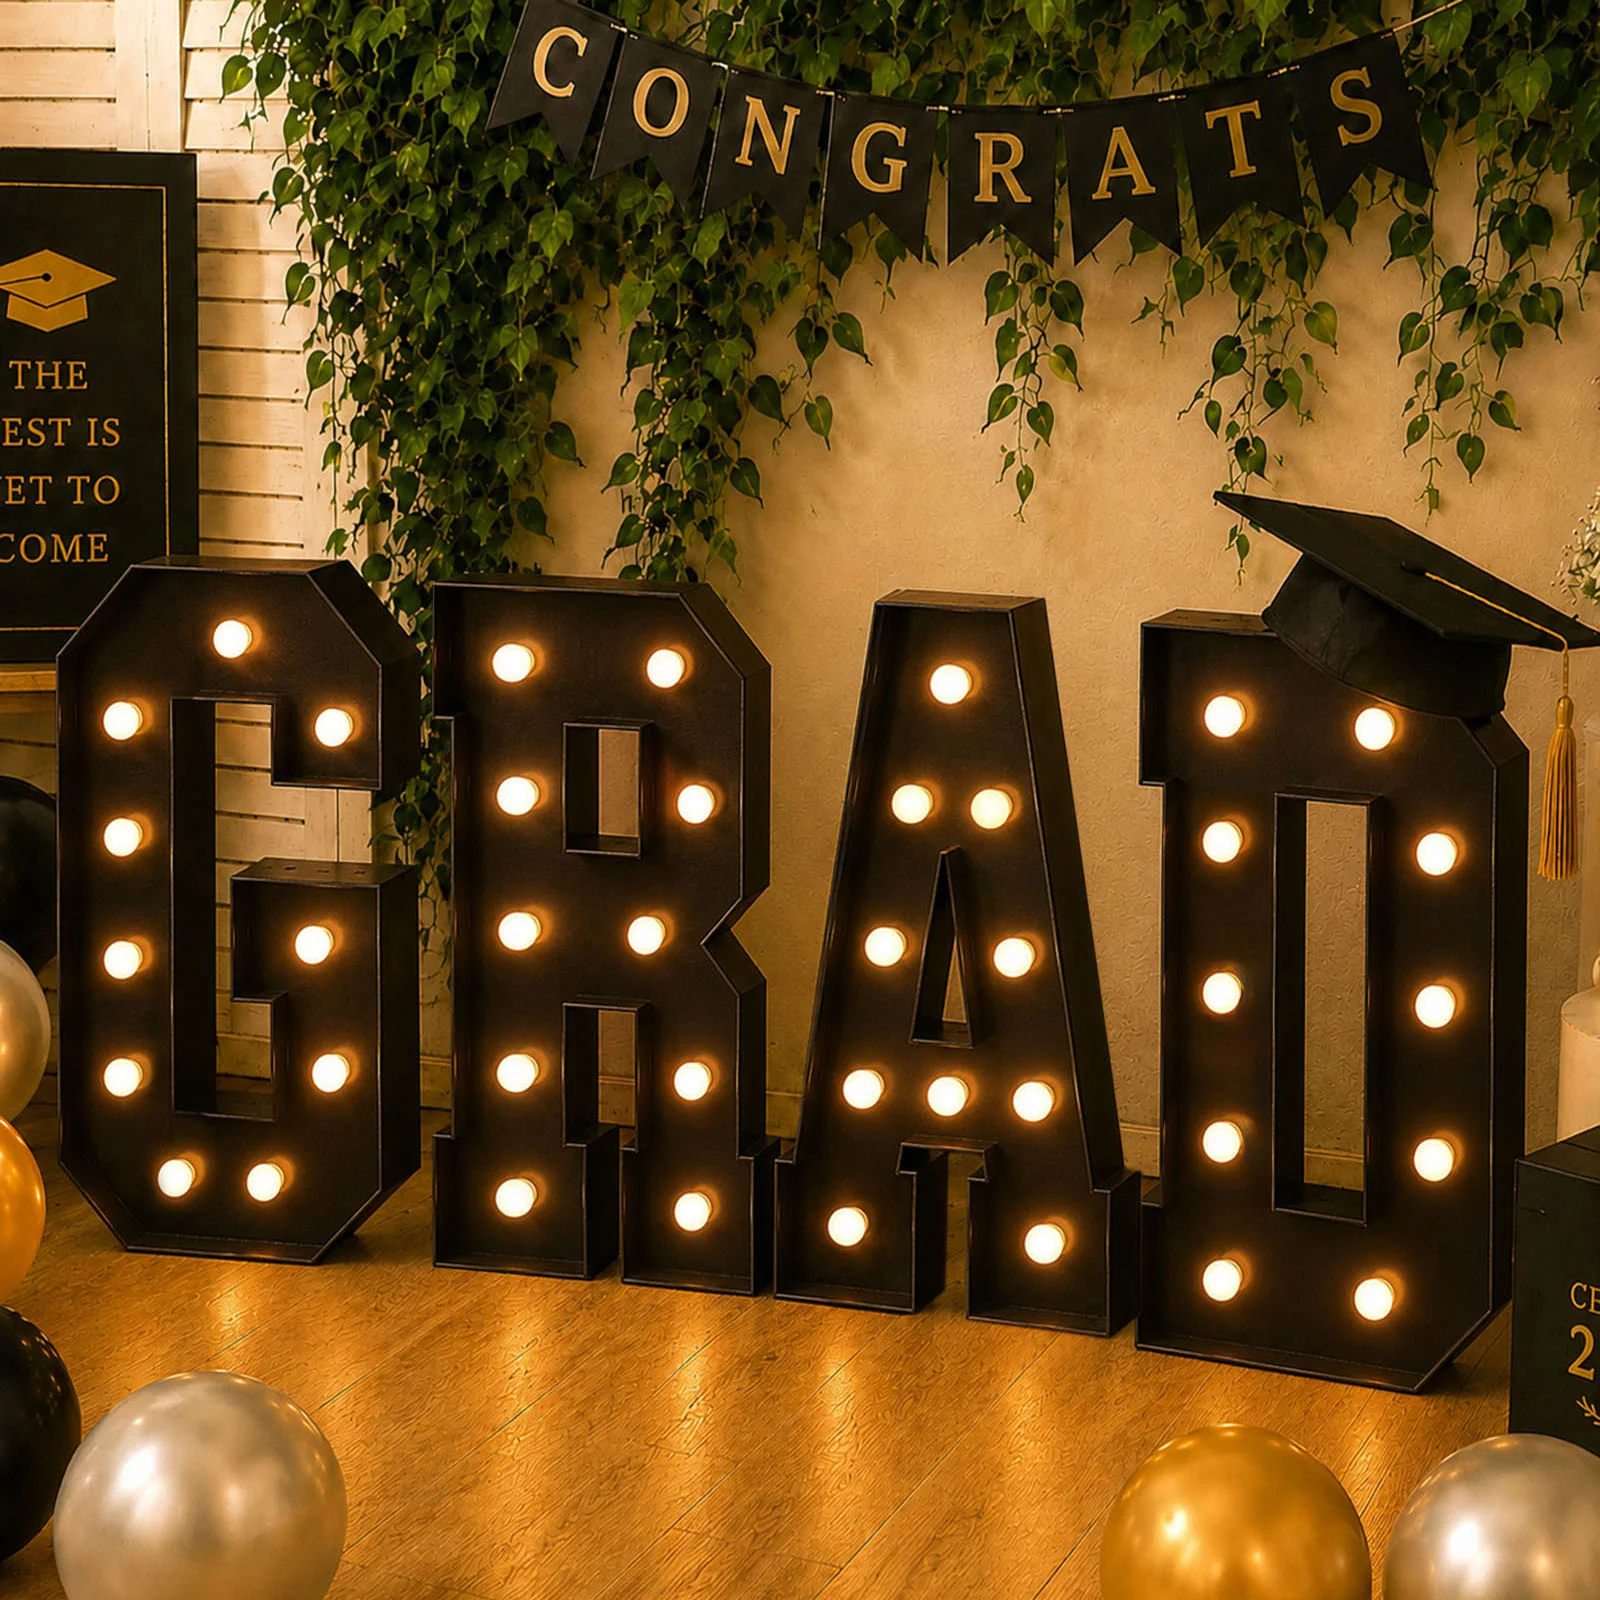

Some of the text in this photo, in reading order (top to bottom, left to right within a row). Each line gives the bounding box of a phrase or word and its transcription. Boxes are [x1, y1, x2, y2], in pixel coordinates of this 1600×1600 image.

[533, 26, 1384, 204] CONGRATS
[9, 360, 88, 390] THE
[87, 417, 121, 447] IS
[0, 474, 120, 505] ET TO
[56, 558, 1531, 1393] GRAD
[1567, 1324, 1595, 1381] 2
